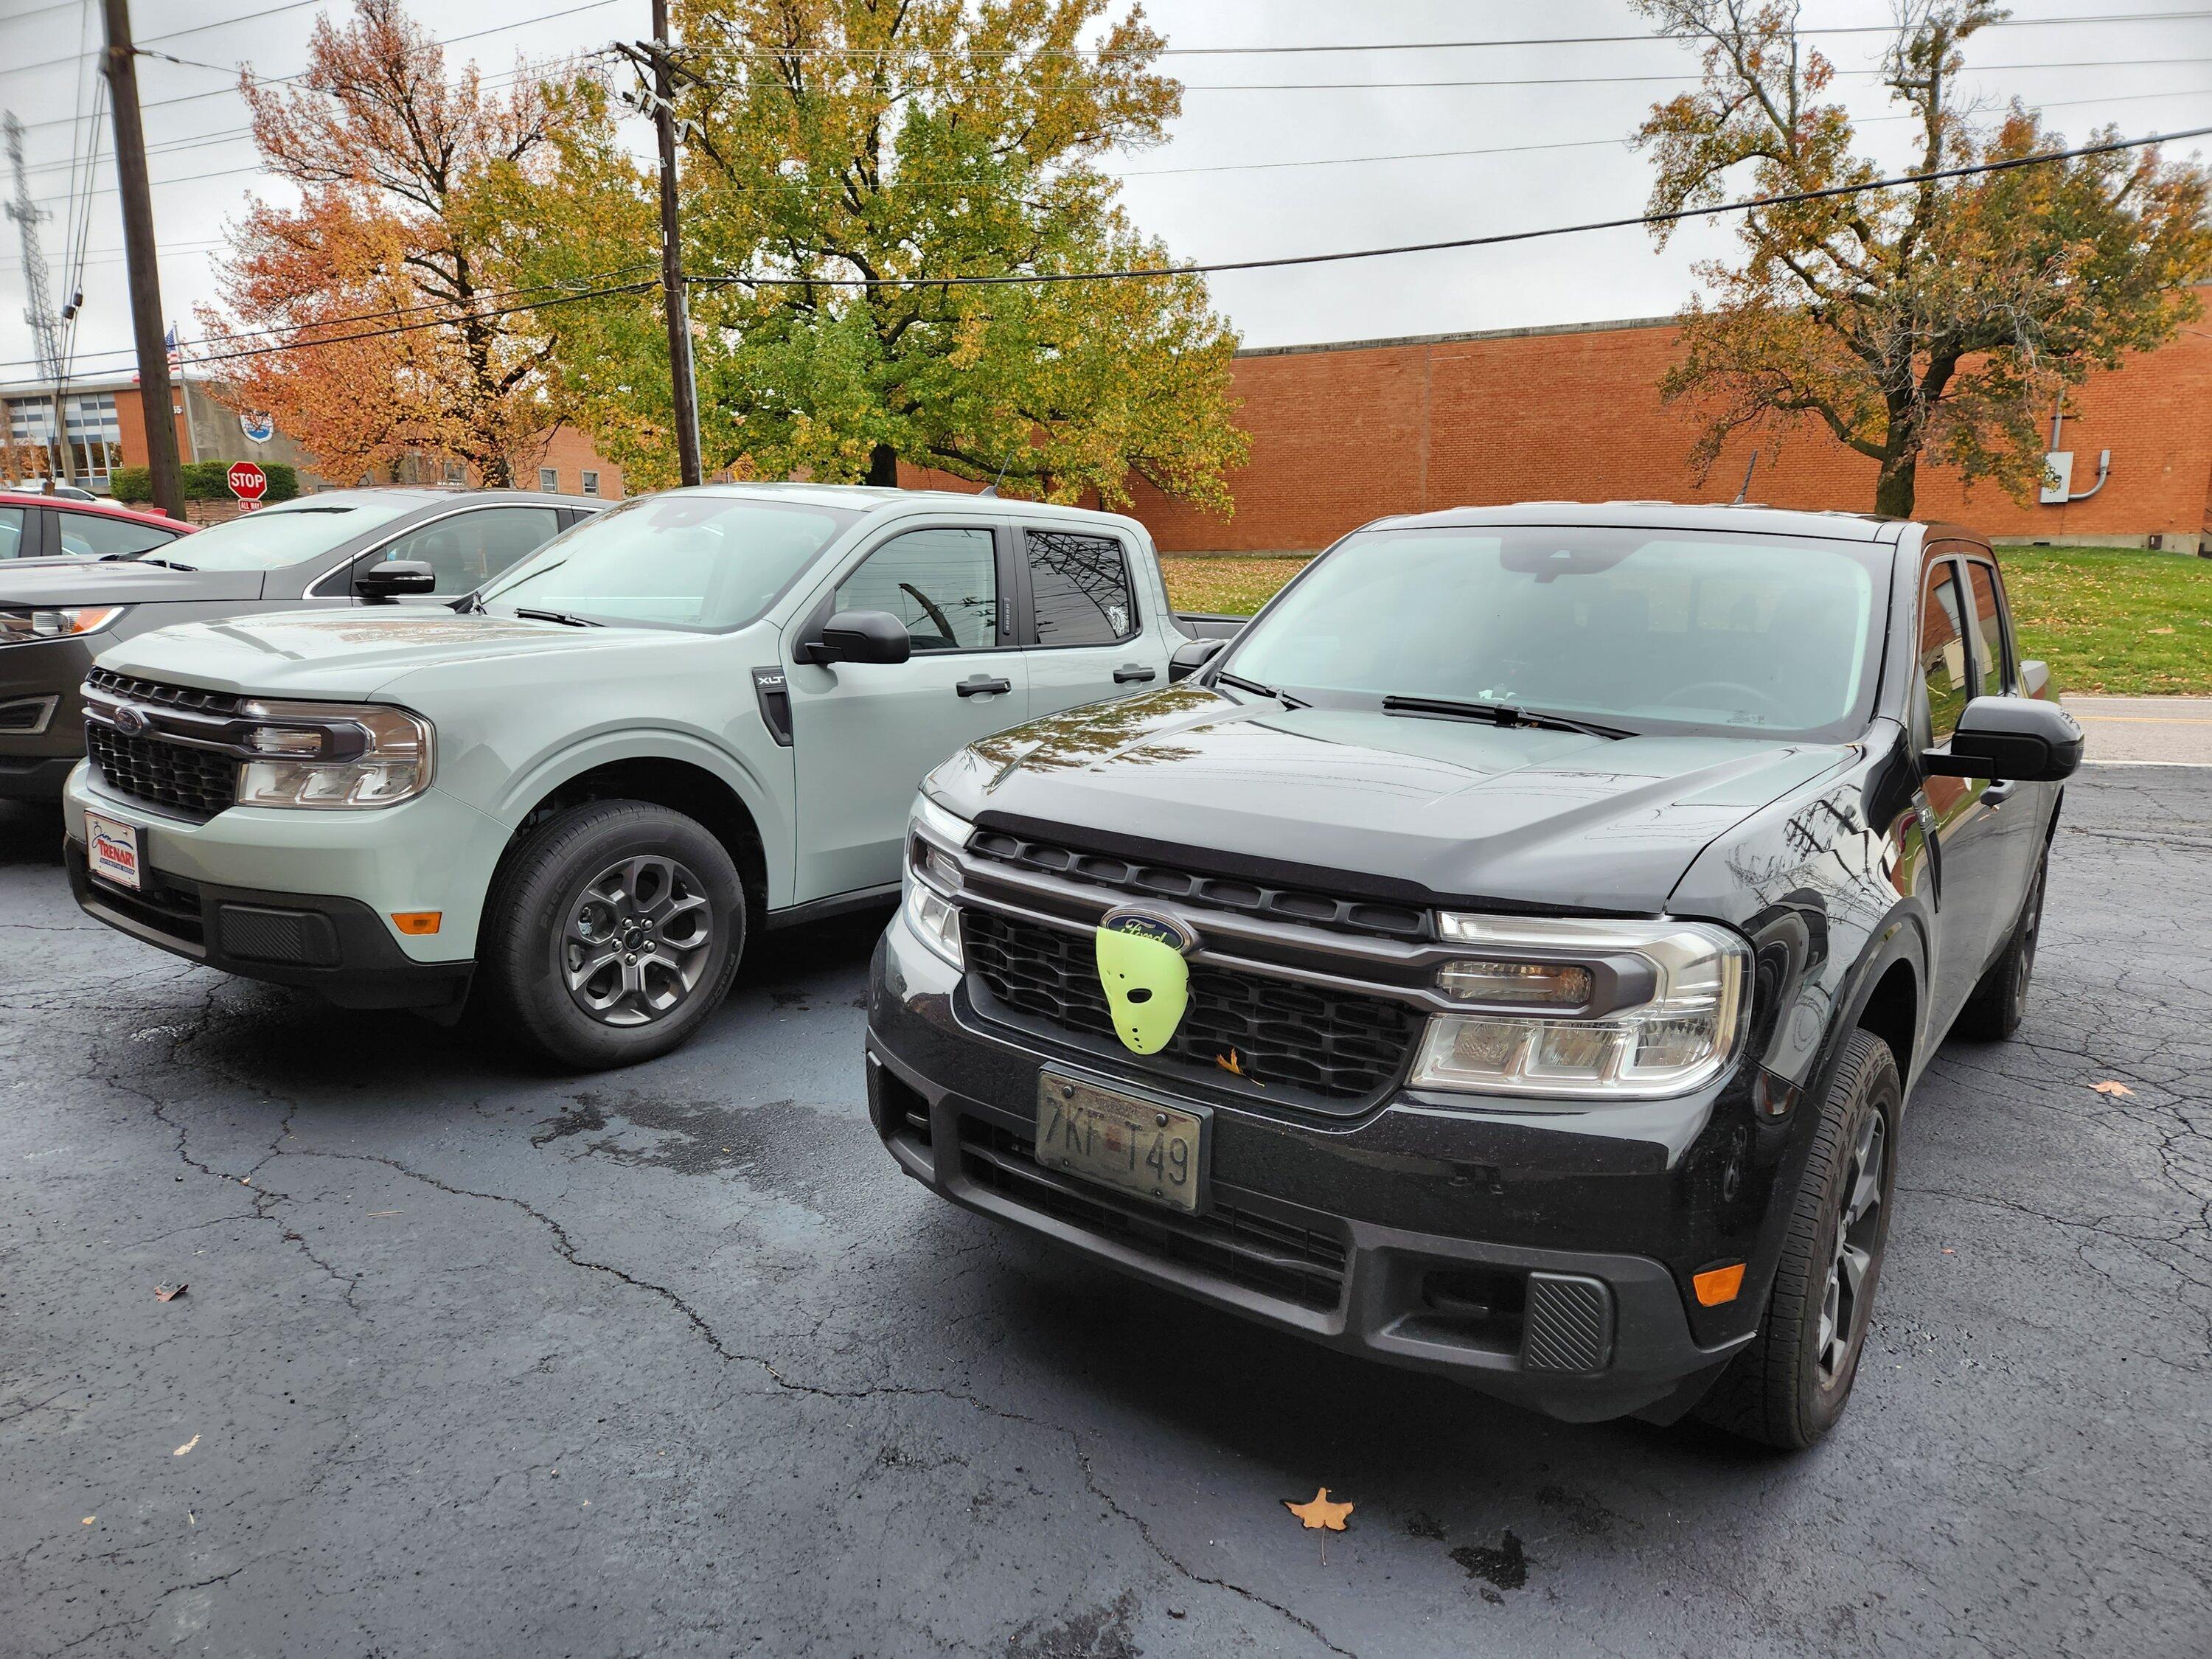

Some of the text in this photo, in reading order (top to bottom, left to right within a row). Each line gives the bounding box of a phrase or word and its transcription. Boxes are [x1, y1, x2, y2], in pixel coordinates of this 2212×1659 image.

[231, 473, 263, 488] STOP
[241, 501, 260, 510] ALL WAY
[758, 676, 784, 685] XLT
[98, 838, 135, 868] TRENARY
[1124, 1120, 1189, 1186] T49
